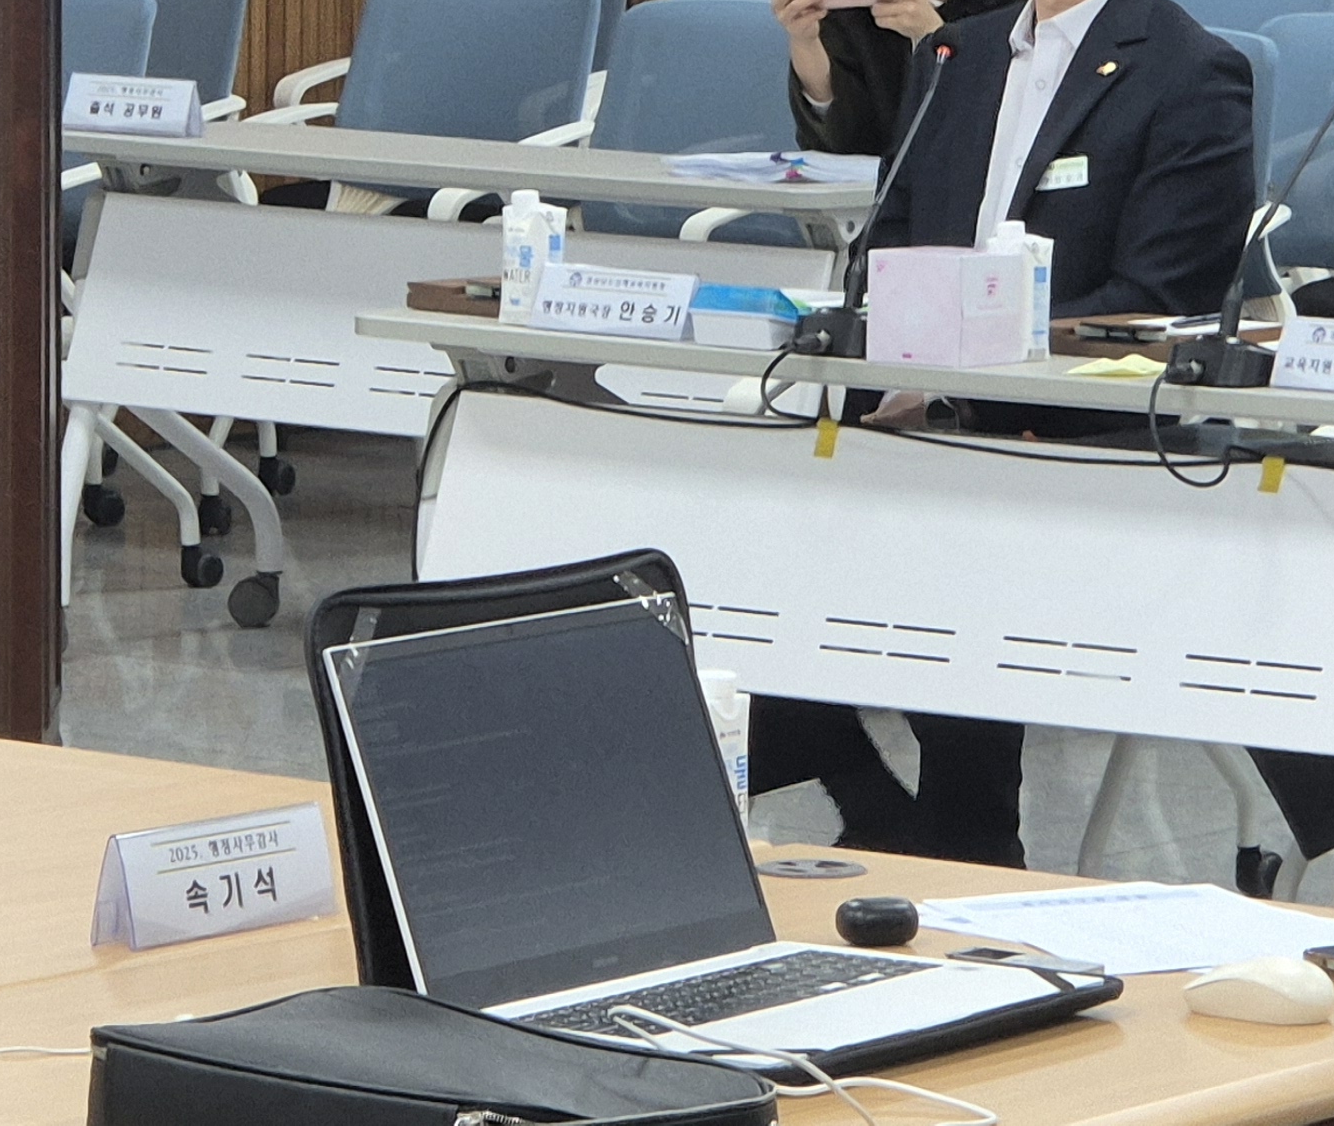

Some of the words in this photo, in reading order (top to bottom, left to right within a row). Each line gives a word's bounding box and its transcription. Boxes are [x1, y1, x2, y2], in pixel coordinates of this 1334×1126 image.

[619, 300, 682, 325] 안승기
[168, 843, 204, 863] 2025.
[208, 829, 280, 858] 행정사무감사
[185, 865, 278, 915] 속기석
